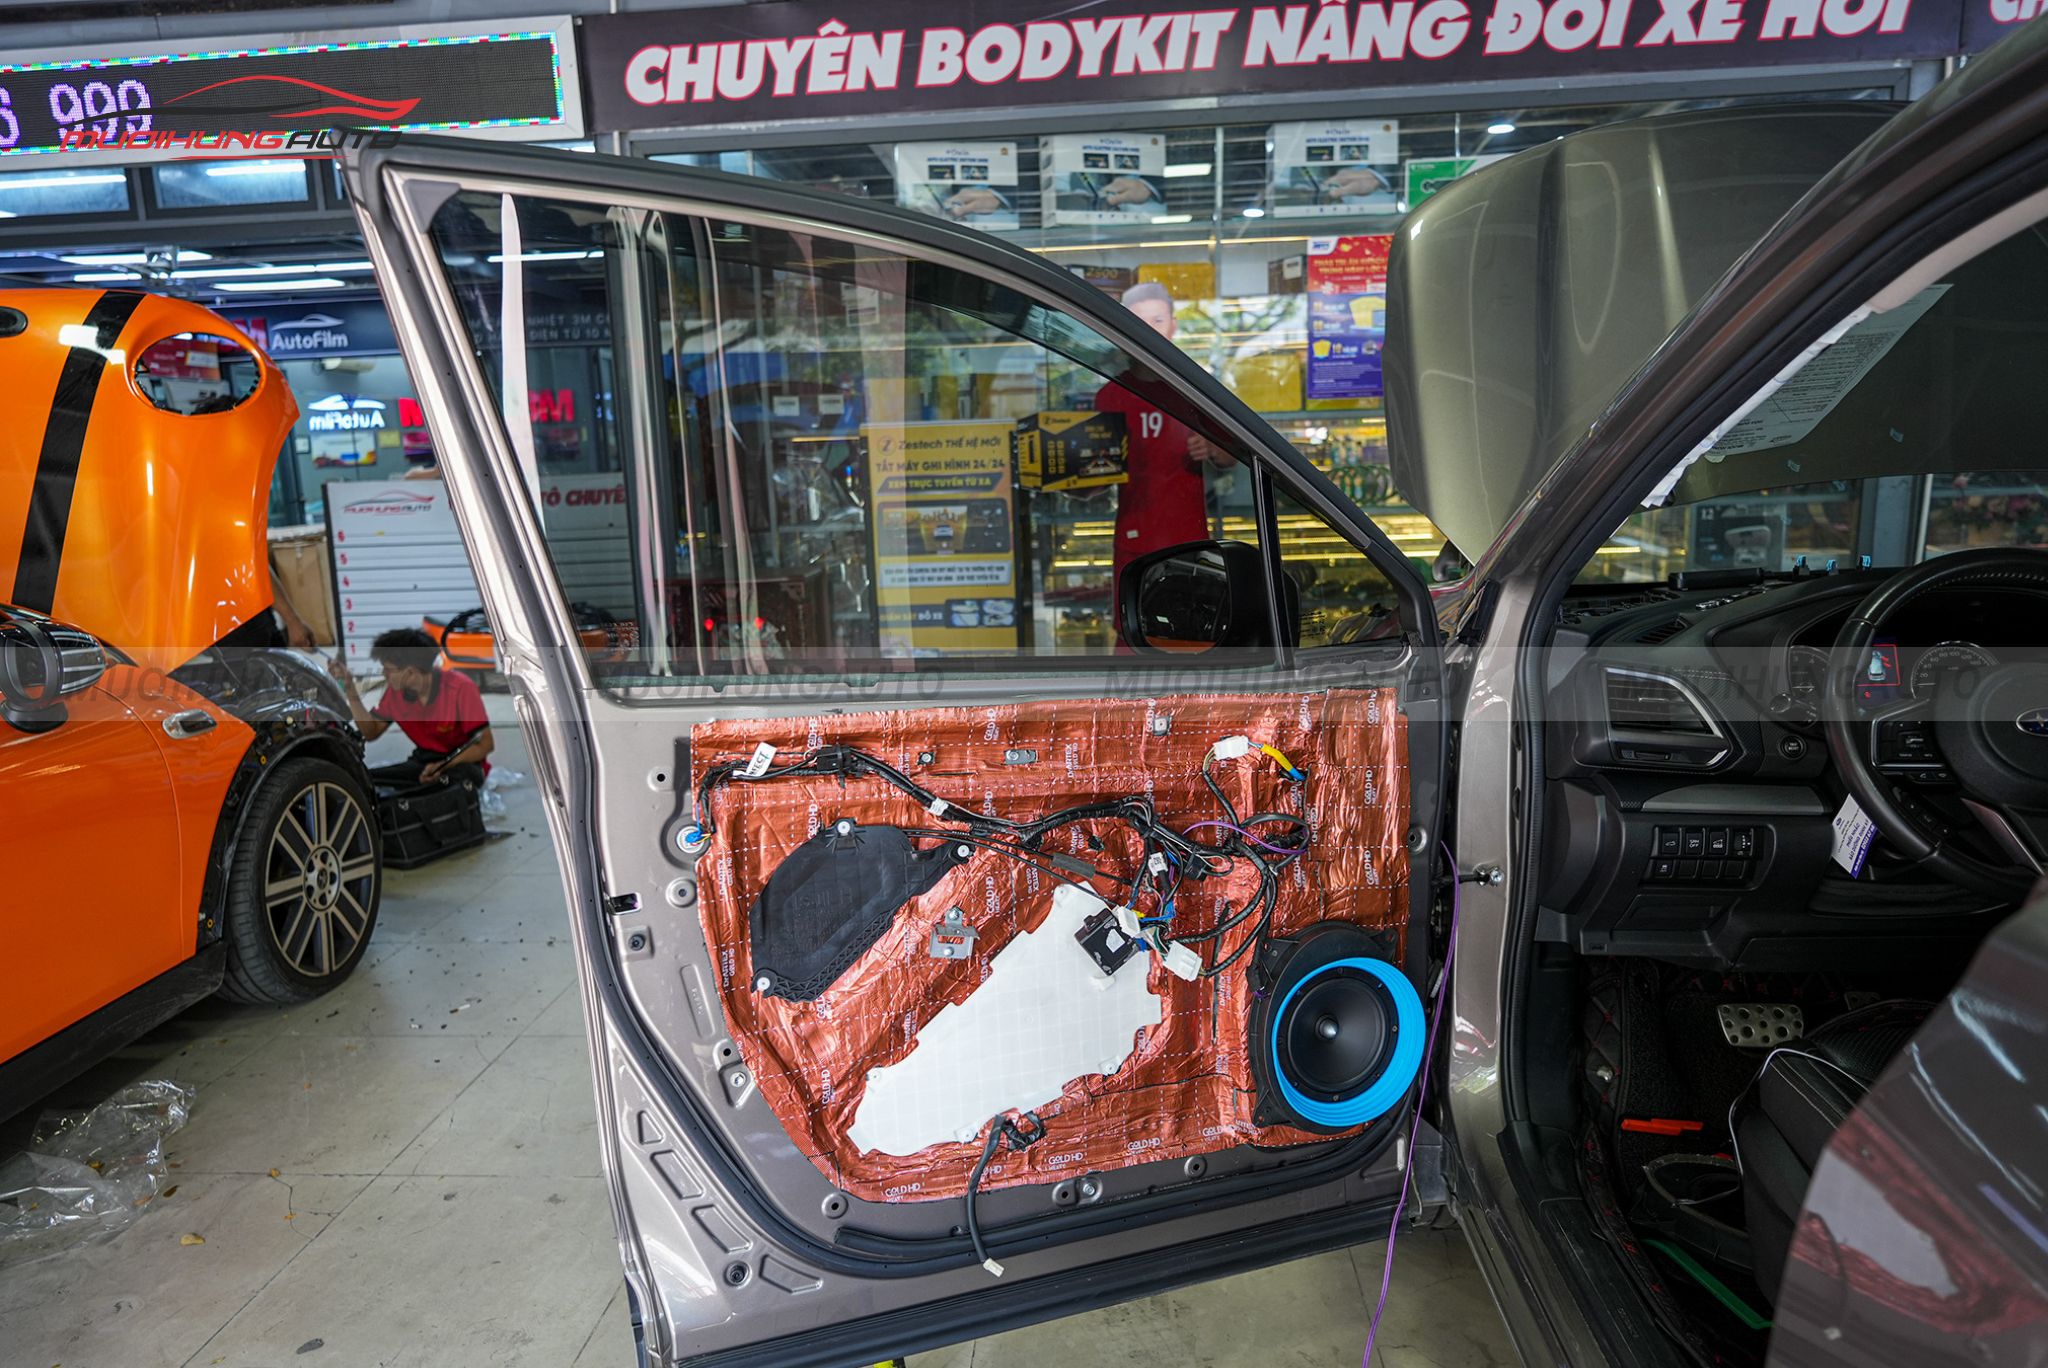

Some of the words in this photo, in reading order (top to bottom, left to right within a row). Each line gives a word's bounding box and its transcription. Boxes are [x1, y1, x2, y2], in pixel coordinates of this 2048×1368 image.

[625, 18, 904, 104] CHUYÊN
[915, 8, 1238, 88] BODYKIT
[1634, 0, 1745, 48] XE
[272, 330, 348, 350] AutoFilm
[1140, 412, 1163, 439] 19
[922, 460, 942, 471] GHI
[566, 483, 625, 506] CHUYÊ
[338, 531, 345, 542] 6
[340, 554, 347, 565] 5
[343, 577, 350, 588] 4
[345, 599, 352, 610] 3
[348, 621, 355, 633] 2
[351, 643, 356, 654] 1
[1148, 698, 1156, 713] HD
[987, 708, 996, 722] HD
[1368, 704, 1376, 724] GOLD
[808, 718, 817, 733] HD
[1146, 713, 1154, 732] GOLD
[984, 722, 995, 741] GOLD
[1365, 769, 1373, 783] HD
[1365, 784, 1373, 805] GOLD
[807, 803, 817, 816] HD
[807, 817, 817, 839] GOLD
[1364, 850, 1372, 865] HD
[985, 875, 994, 891] HD
[1293, 869, 1301, 889] GOLD
[985, 891, 994, 915] GOLD
[822, 1069, 831, 1084] HD
[822, 1083, 831, 1105] GOLD
[1203, 1125, 1223, 1137] GOLD
[1127, 1139, 1147, 1150] GOLD
[1147, 1138, 1161, 1148] HD
[1049, 1154, 1069, 1166] GOLD
[1070, 1152, 1084, 1163] HD
[885, 1185, 907, 1197] GOLD
[907, 1183, 921, 1193] HD
